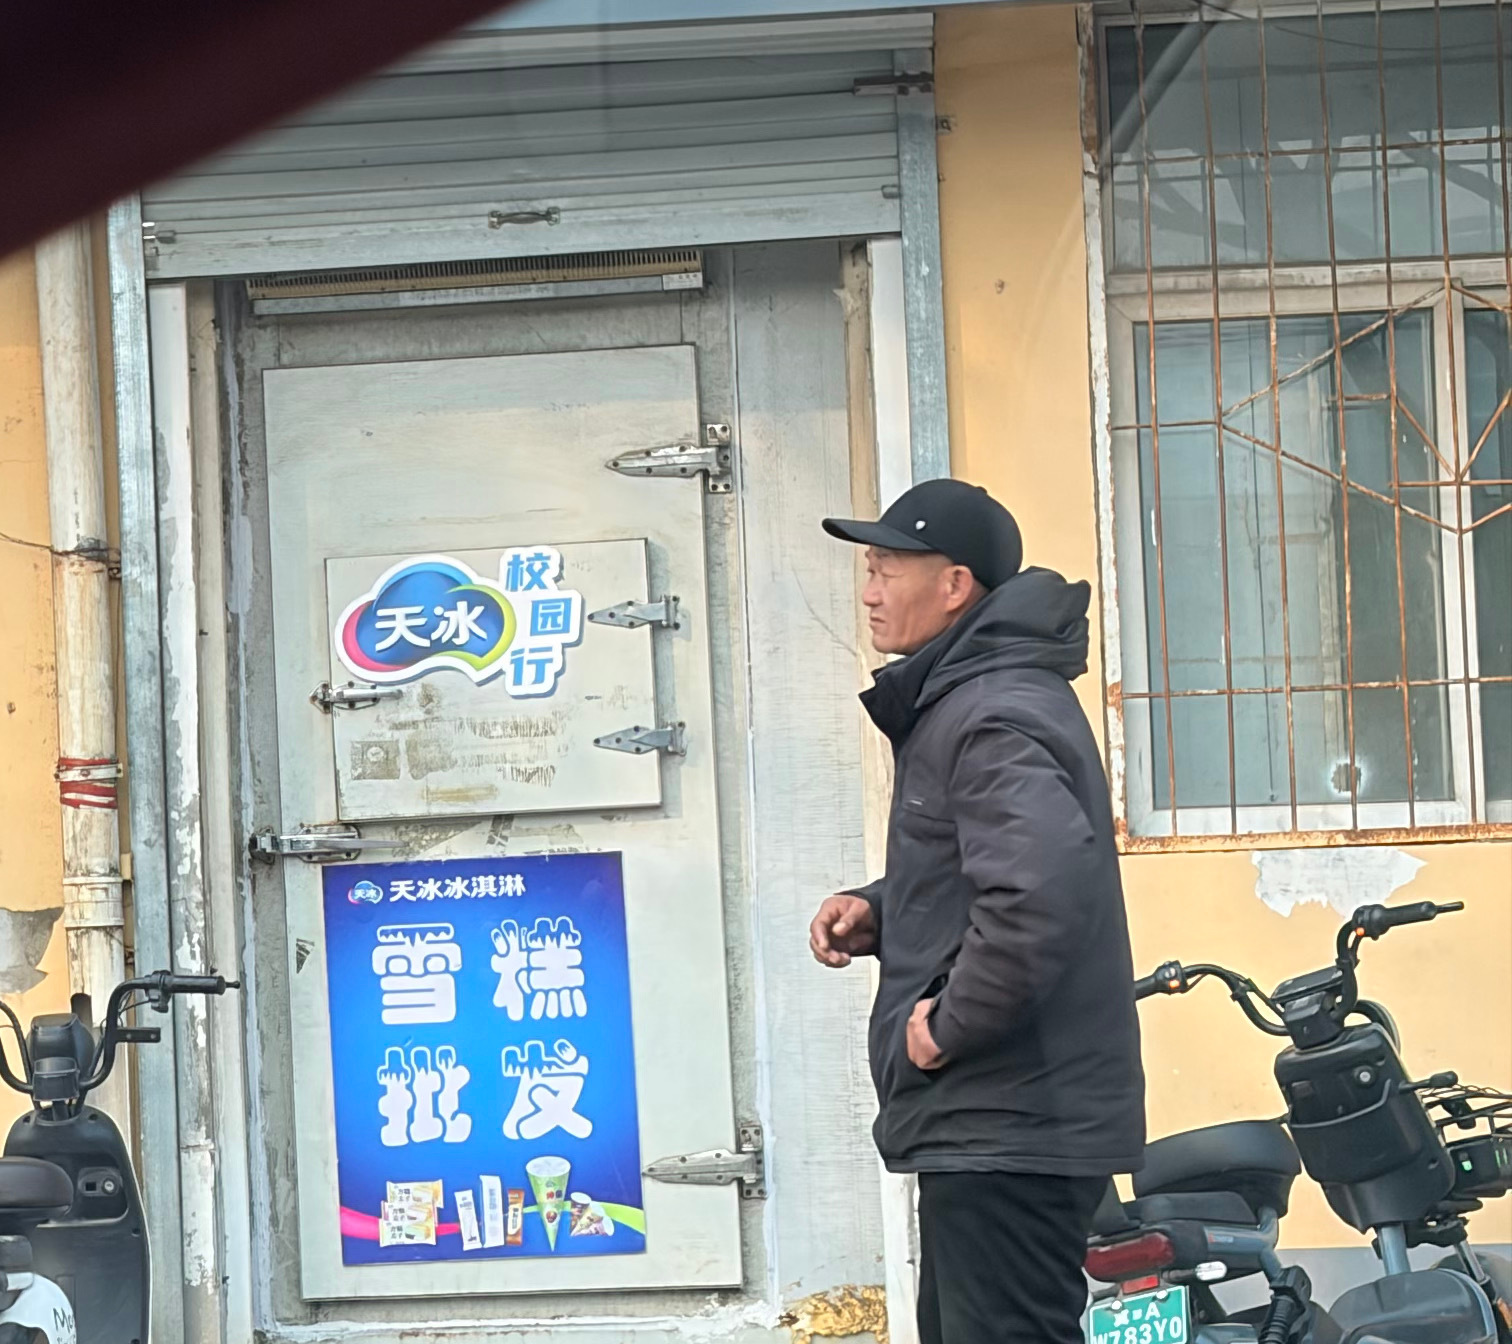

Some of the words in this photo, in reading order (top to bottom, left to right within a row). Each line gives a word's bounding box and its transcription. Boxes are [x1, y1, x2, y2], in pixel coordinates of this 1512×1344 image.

[375, 600, 488, 652] 天冰
[504, 552, 573, 687] 校园行
[389, 873, 527, 903] 天冰冰淇淋
[372, 915, 588, 1025] 雪糕
[377, 1038, 594, 1147] 批发
